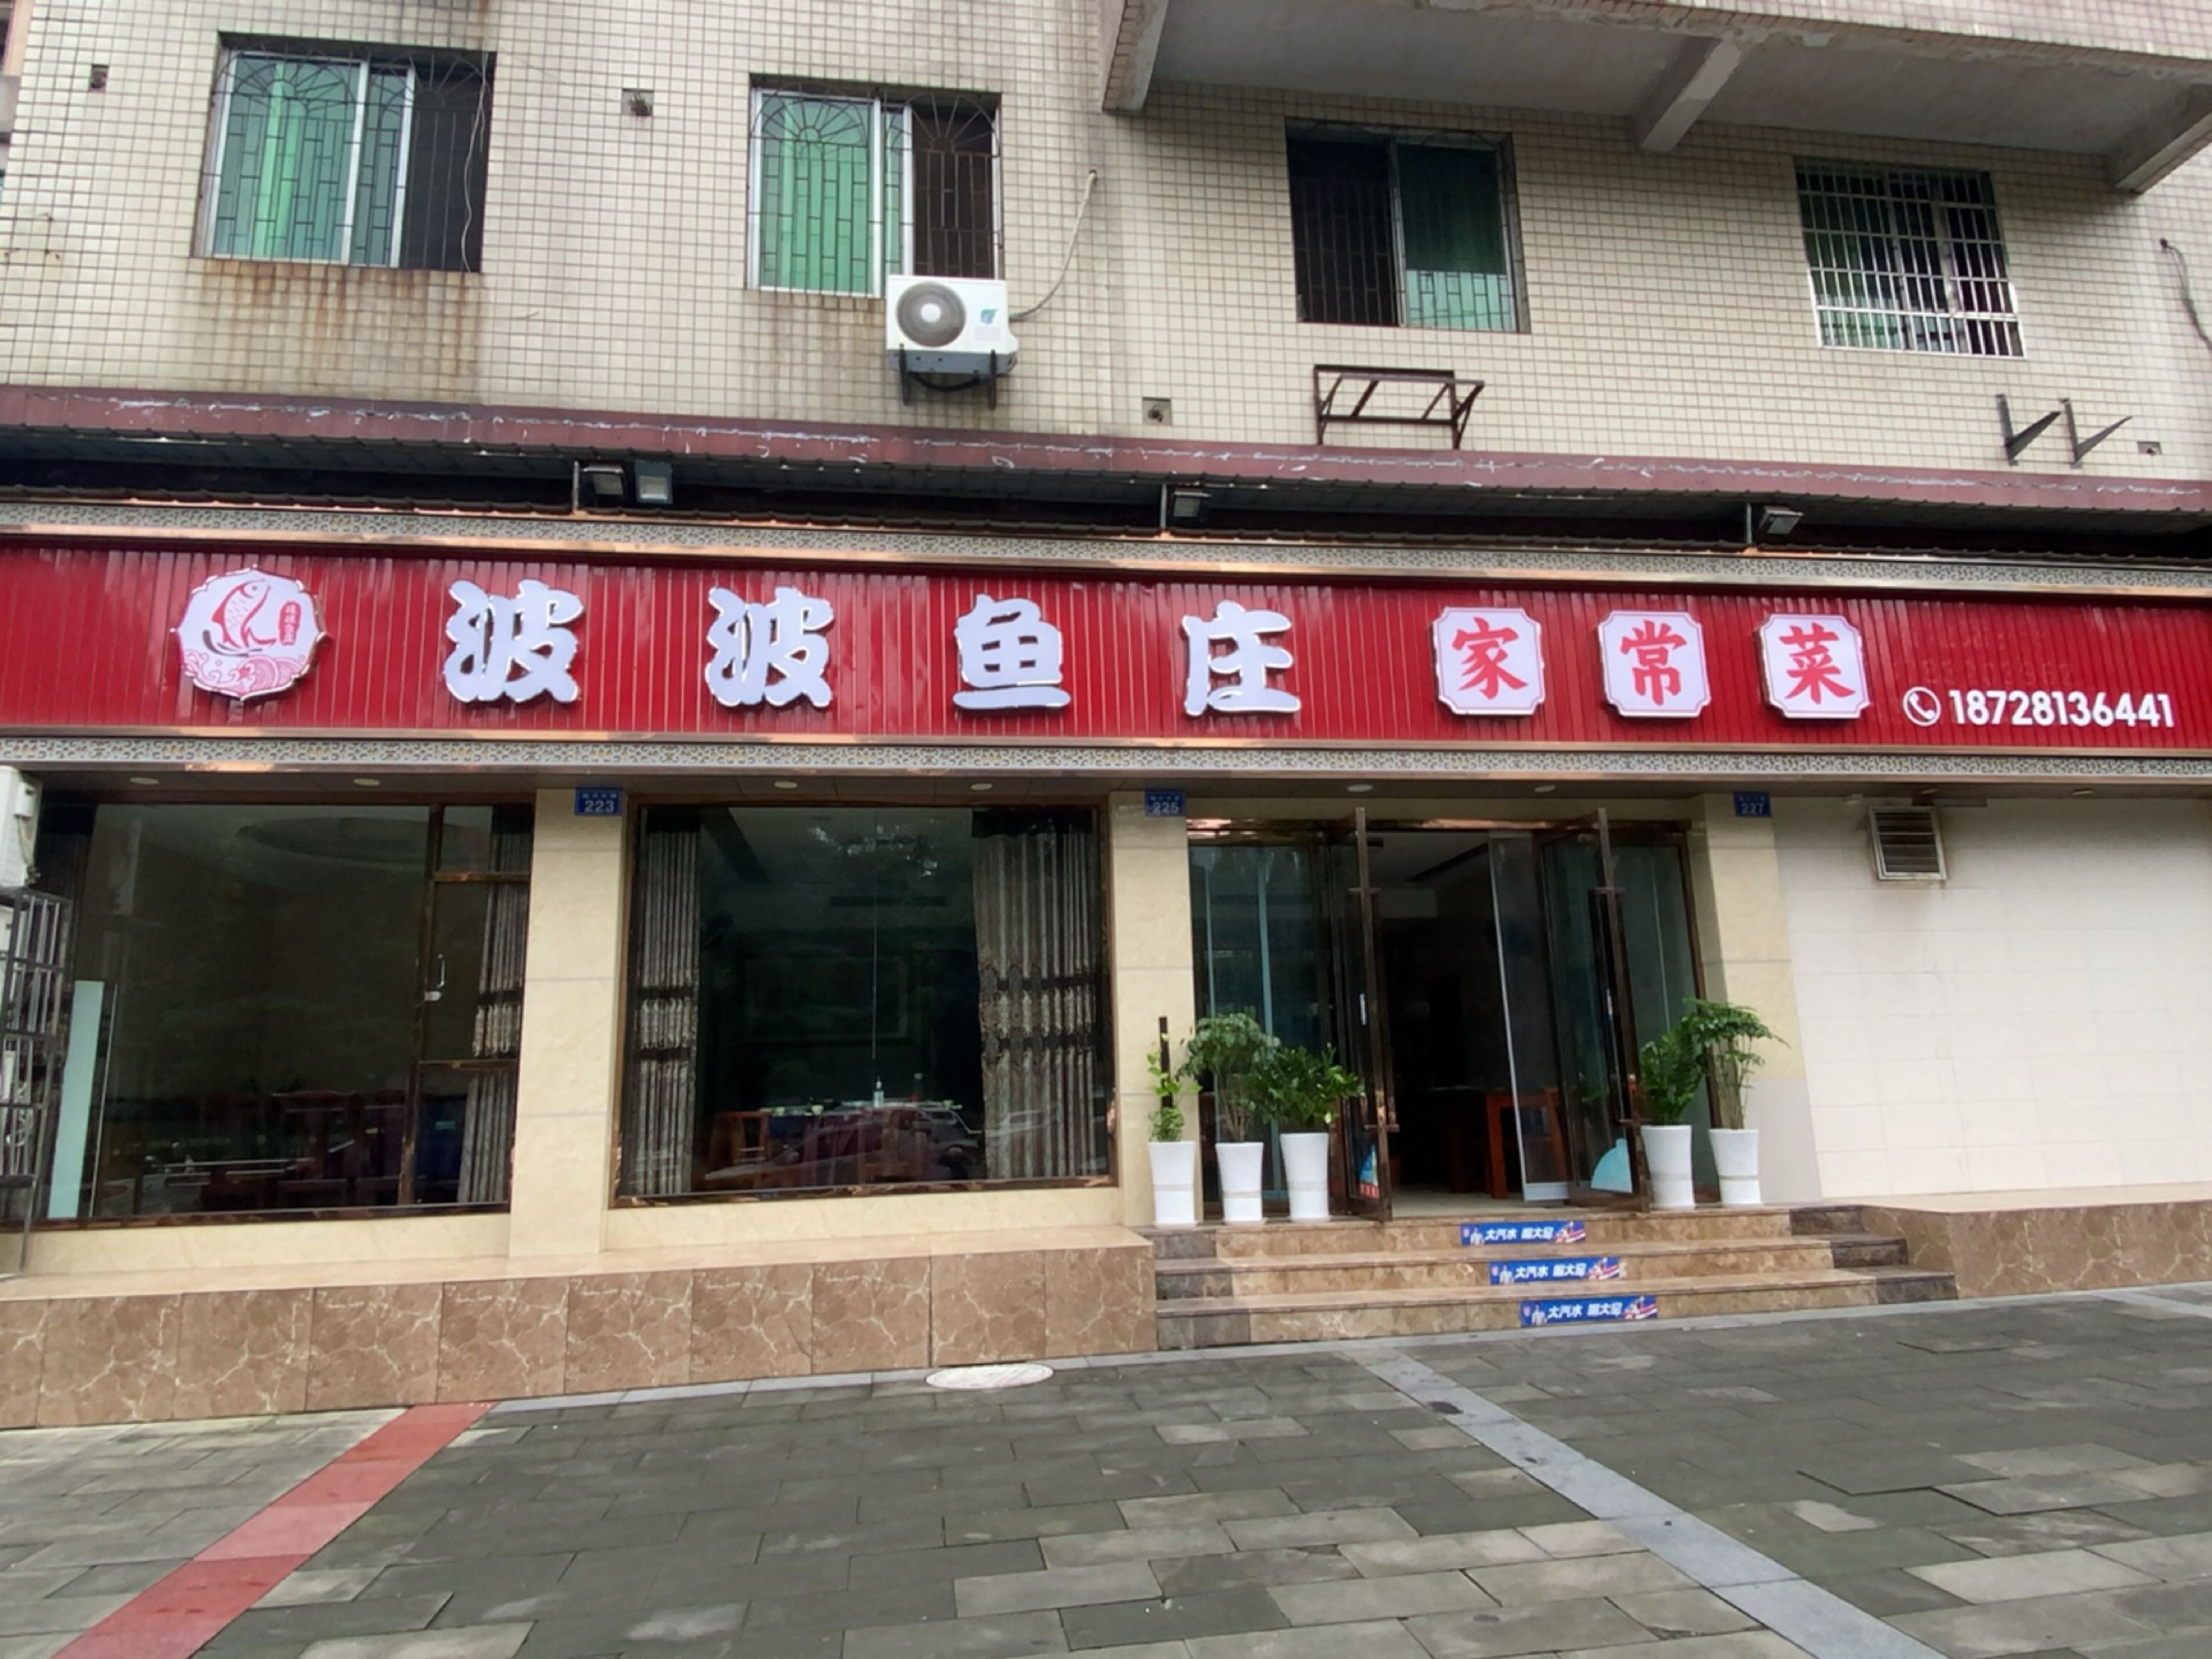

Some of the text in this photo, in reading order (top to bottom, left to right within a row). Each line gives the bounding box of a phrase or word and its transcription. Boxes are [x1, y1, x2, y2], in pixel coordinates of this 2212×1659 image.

[444, 579, 1301, 717] 波波鱼庄
[1450, 616, 1857, 709] 家常菜
[1948, 689, 2175, 728] 18728136441
[584, 799, 614, 812] 223
[1153, 801, 1179, 814] 225
[1741, 802, 1765, 814] 227
[1485, 1228, 1517, 1240] 大汽水
[1515, 1265, 1548, 1278] 大汽水
[1548, 1304, 1583, 1318] 大汽水
